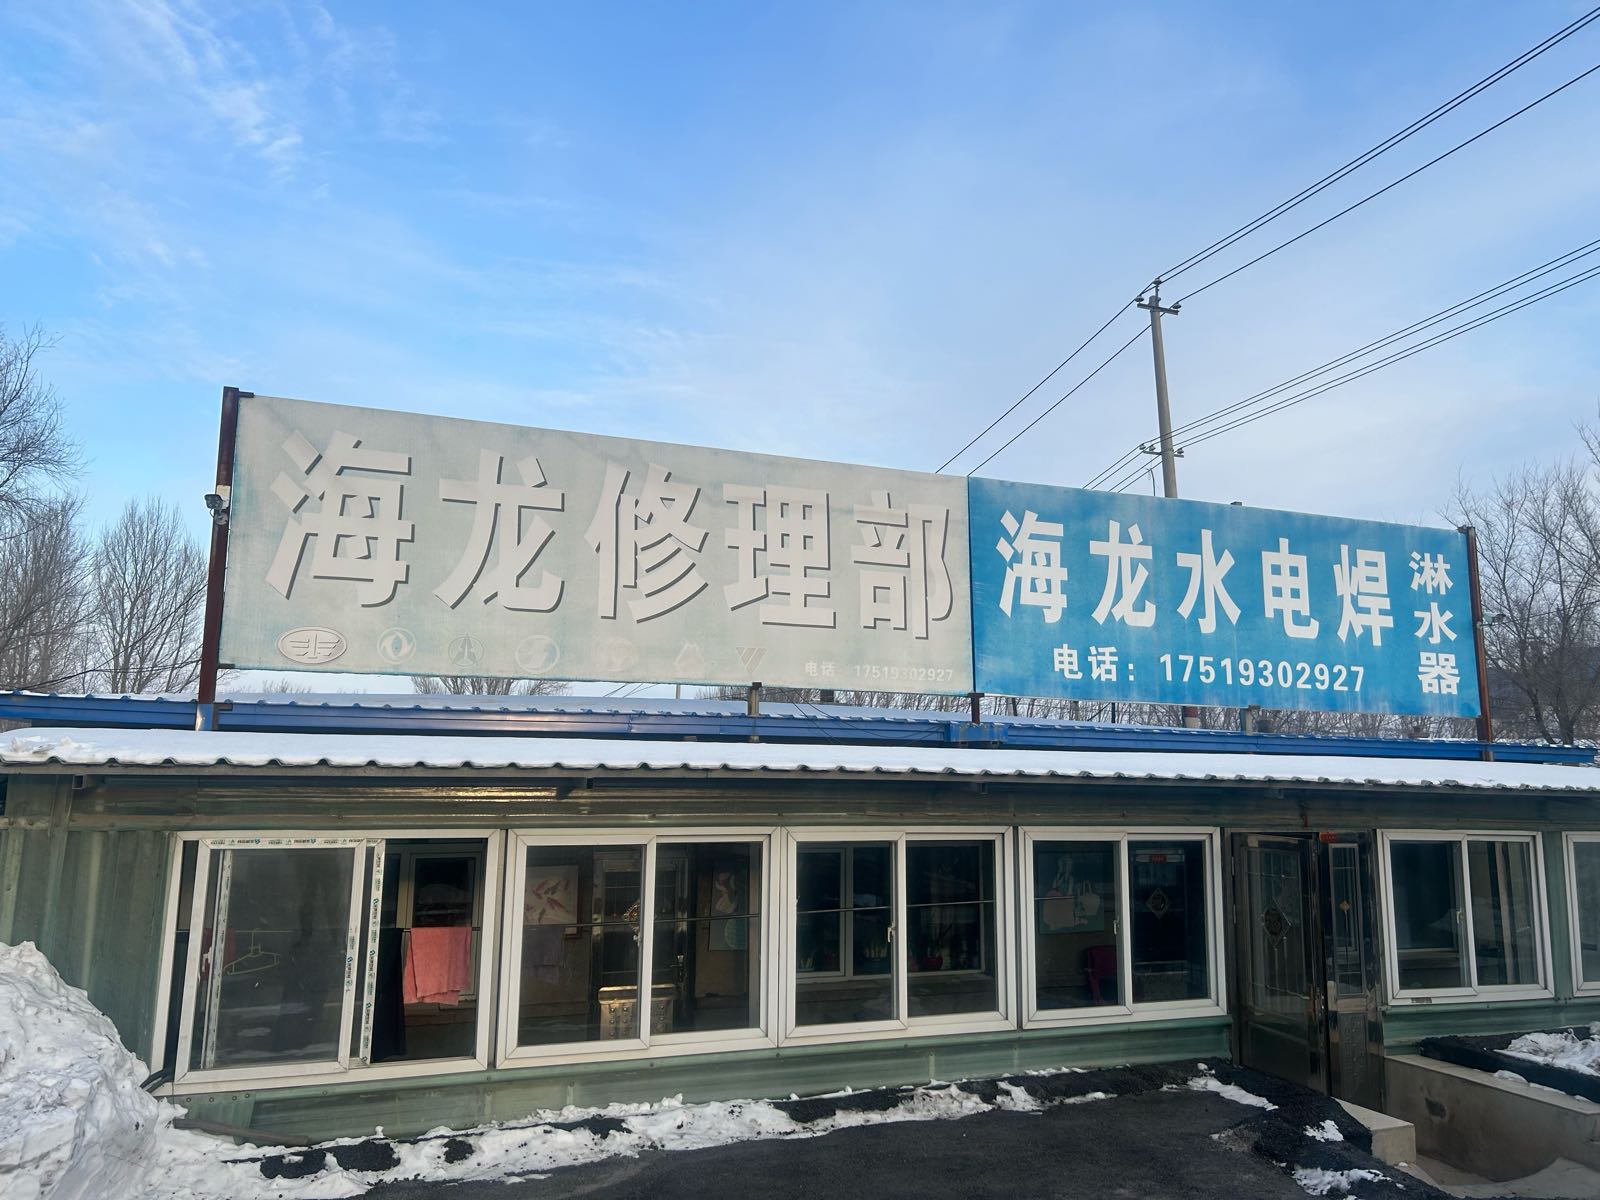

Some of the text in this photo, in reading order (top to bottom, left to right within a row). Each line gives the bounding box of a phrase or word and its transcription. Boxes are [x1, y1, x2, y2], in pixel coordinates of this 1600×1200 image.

[265, 429, 954, 640] 海龙修理部
[996, 509, 1394, 647] 海龙水电焊
[804, 660, 836, 677] 电话
[1160, 653, 1365, 693] 17519302927
[1408, 551, 1461, 695] 淋水器
